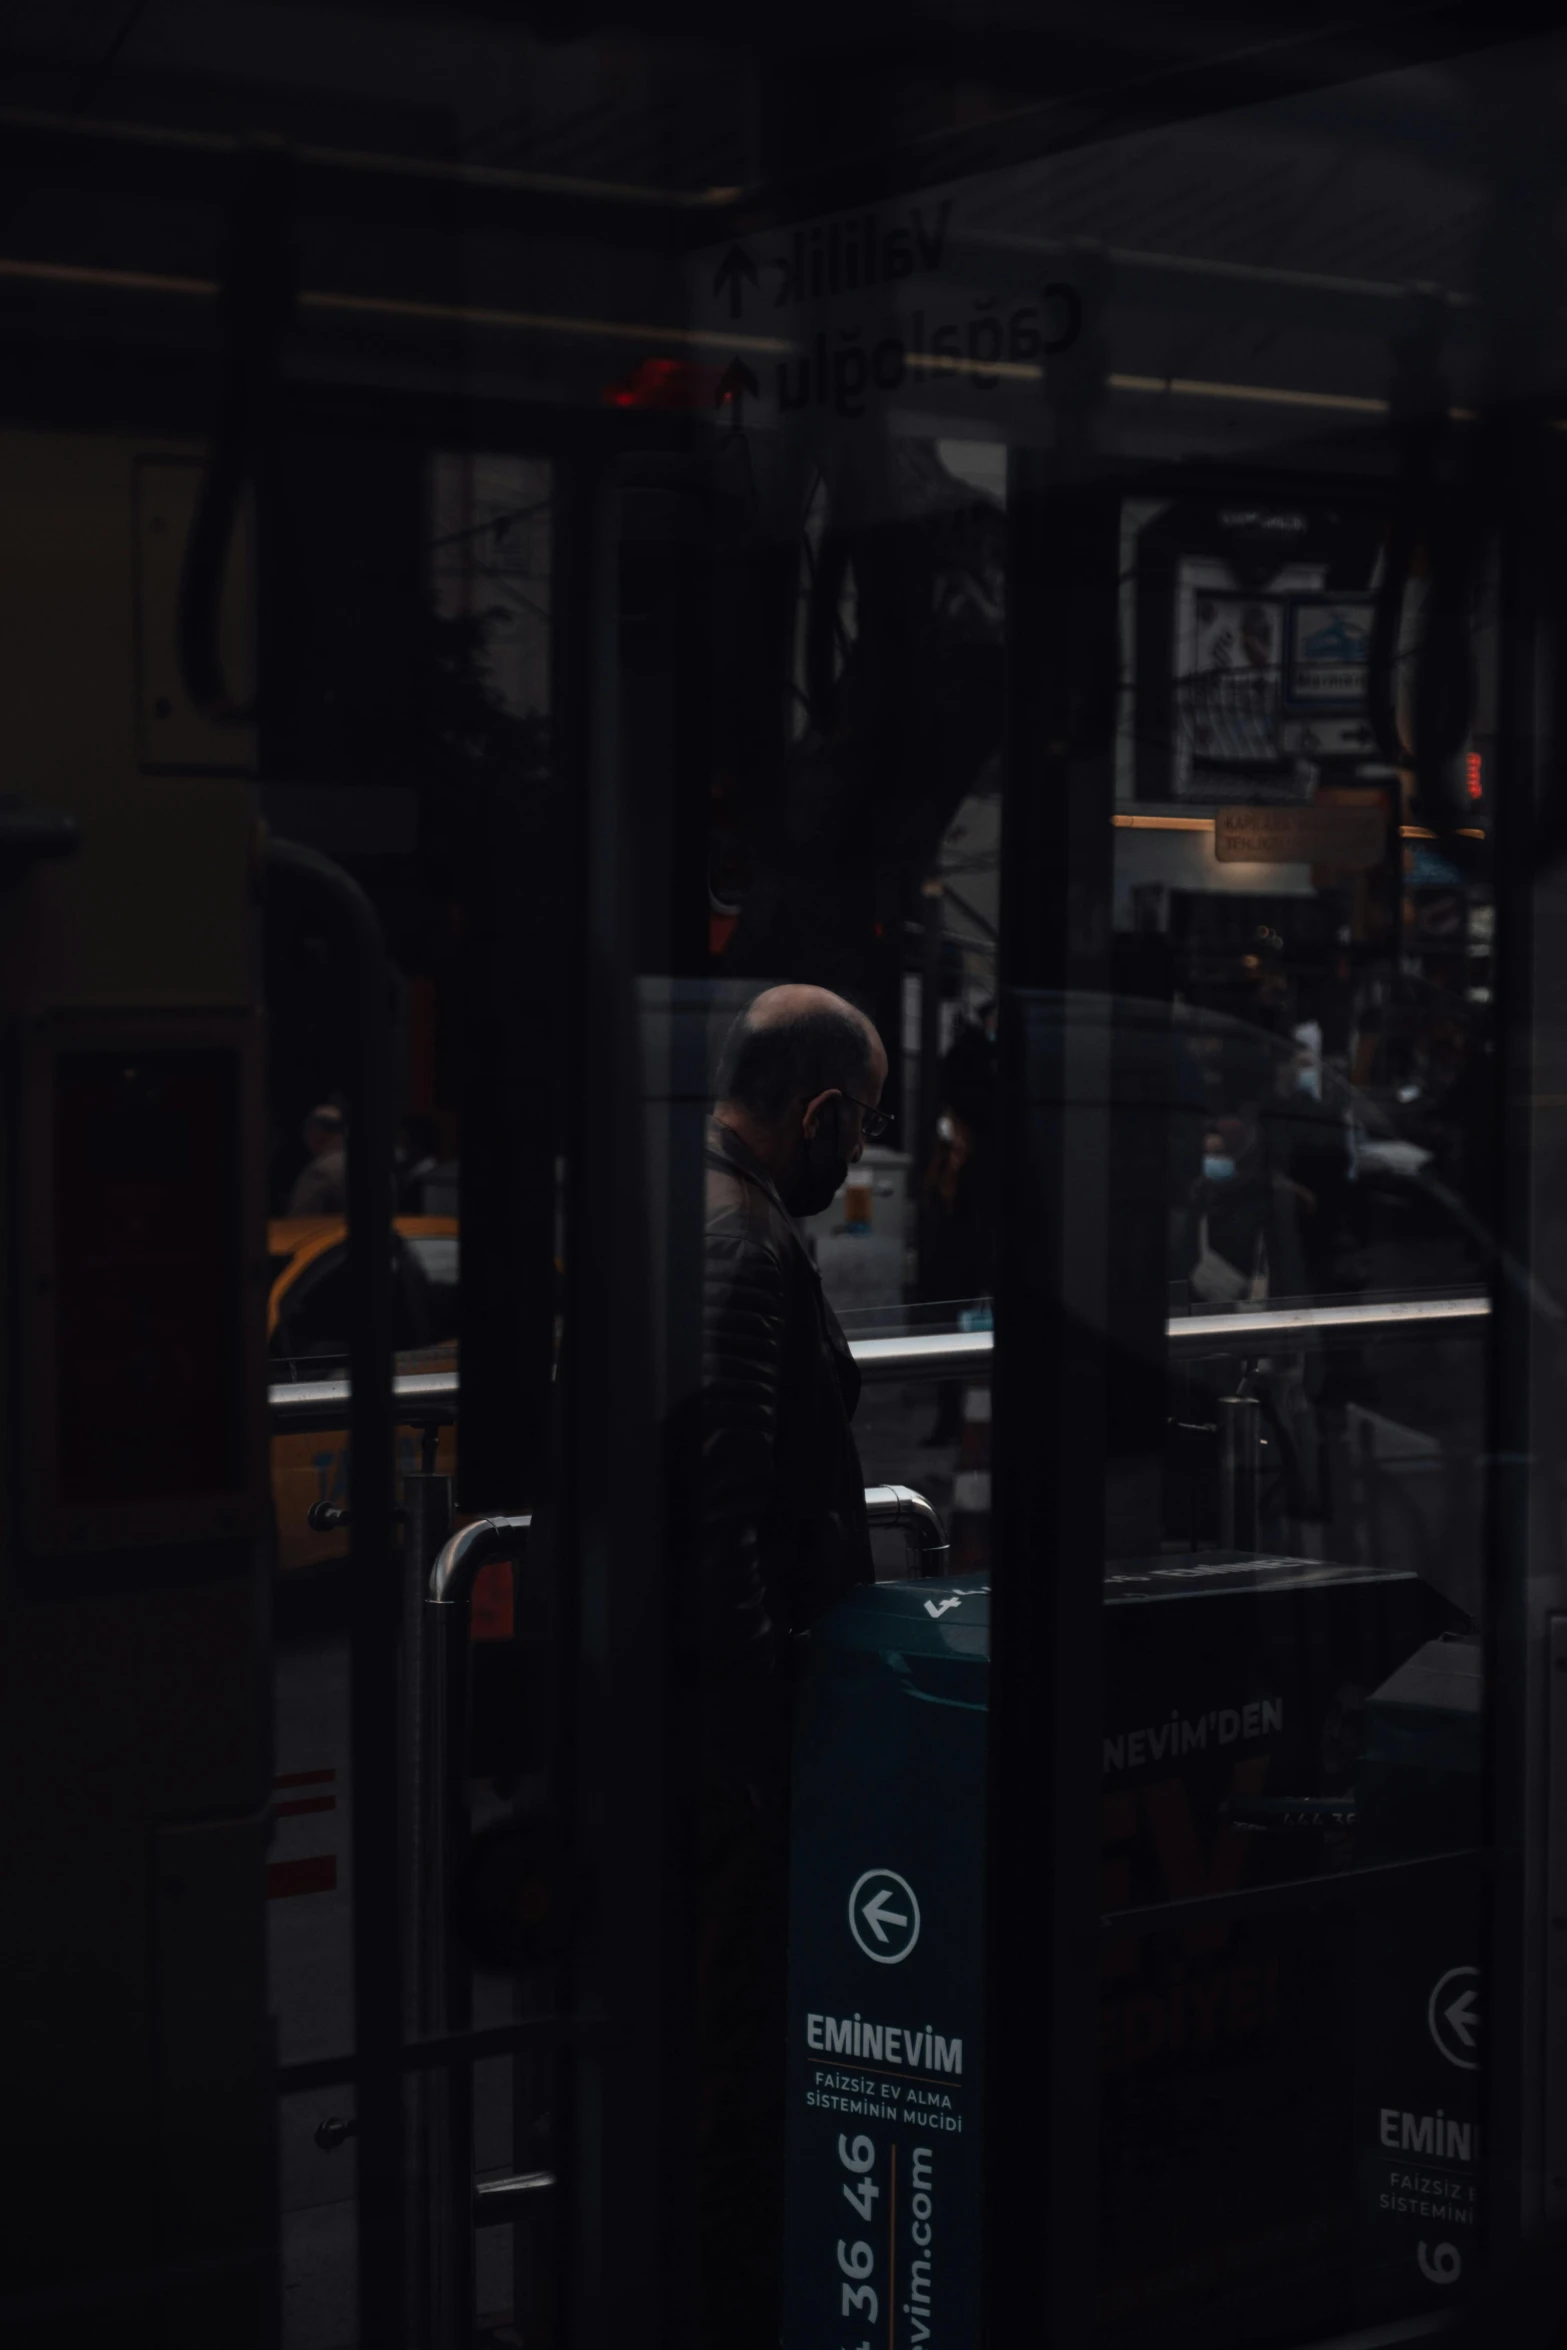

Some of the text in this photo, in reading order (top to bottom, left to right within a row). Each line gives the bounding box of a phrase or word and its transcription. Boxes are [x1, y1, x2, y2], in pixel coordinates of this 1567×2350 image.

[806, 2012, 963, 2075] EMİNEVİM
[806, 2091, 963, 2133] SİSTEMİNİN MUCİDİ
[815, 2071, 952, 2110] FAİZSİZ EV ALMA
[1379, 2108, 1479, 2161] EMİN
[837, 2133, 880, 2222] 46
[1389, 2172, 1461, 2200] FAİZSİZ
[903, 2146, 933, 2350] vim.com
[836, 2239, 879, 2325] 36
